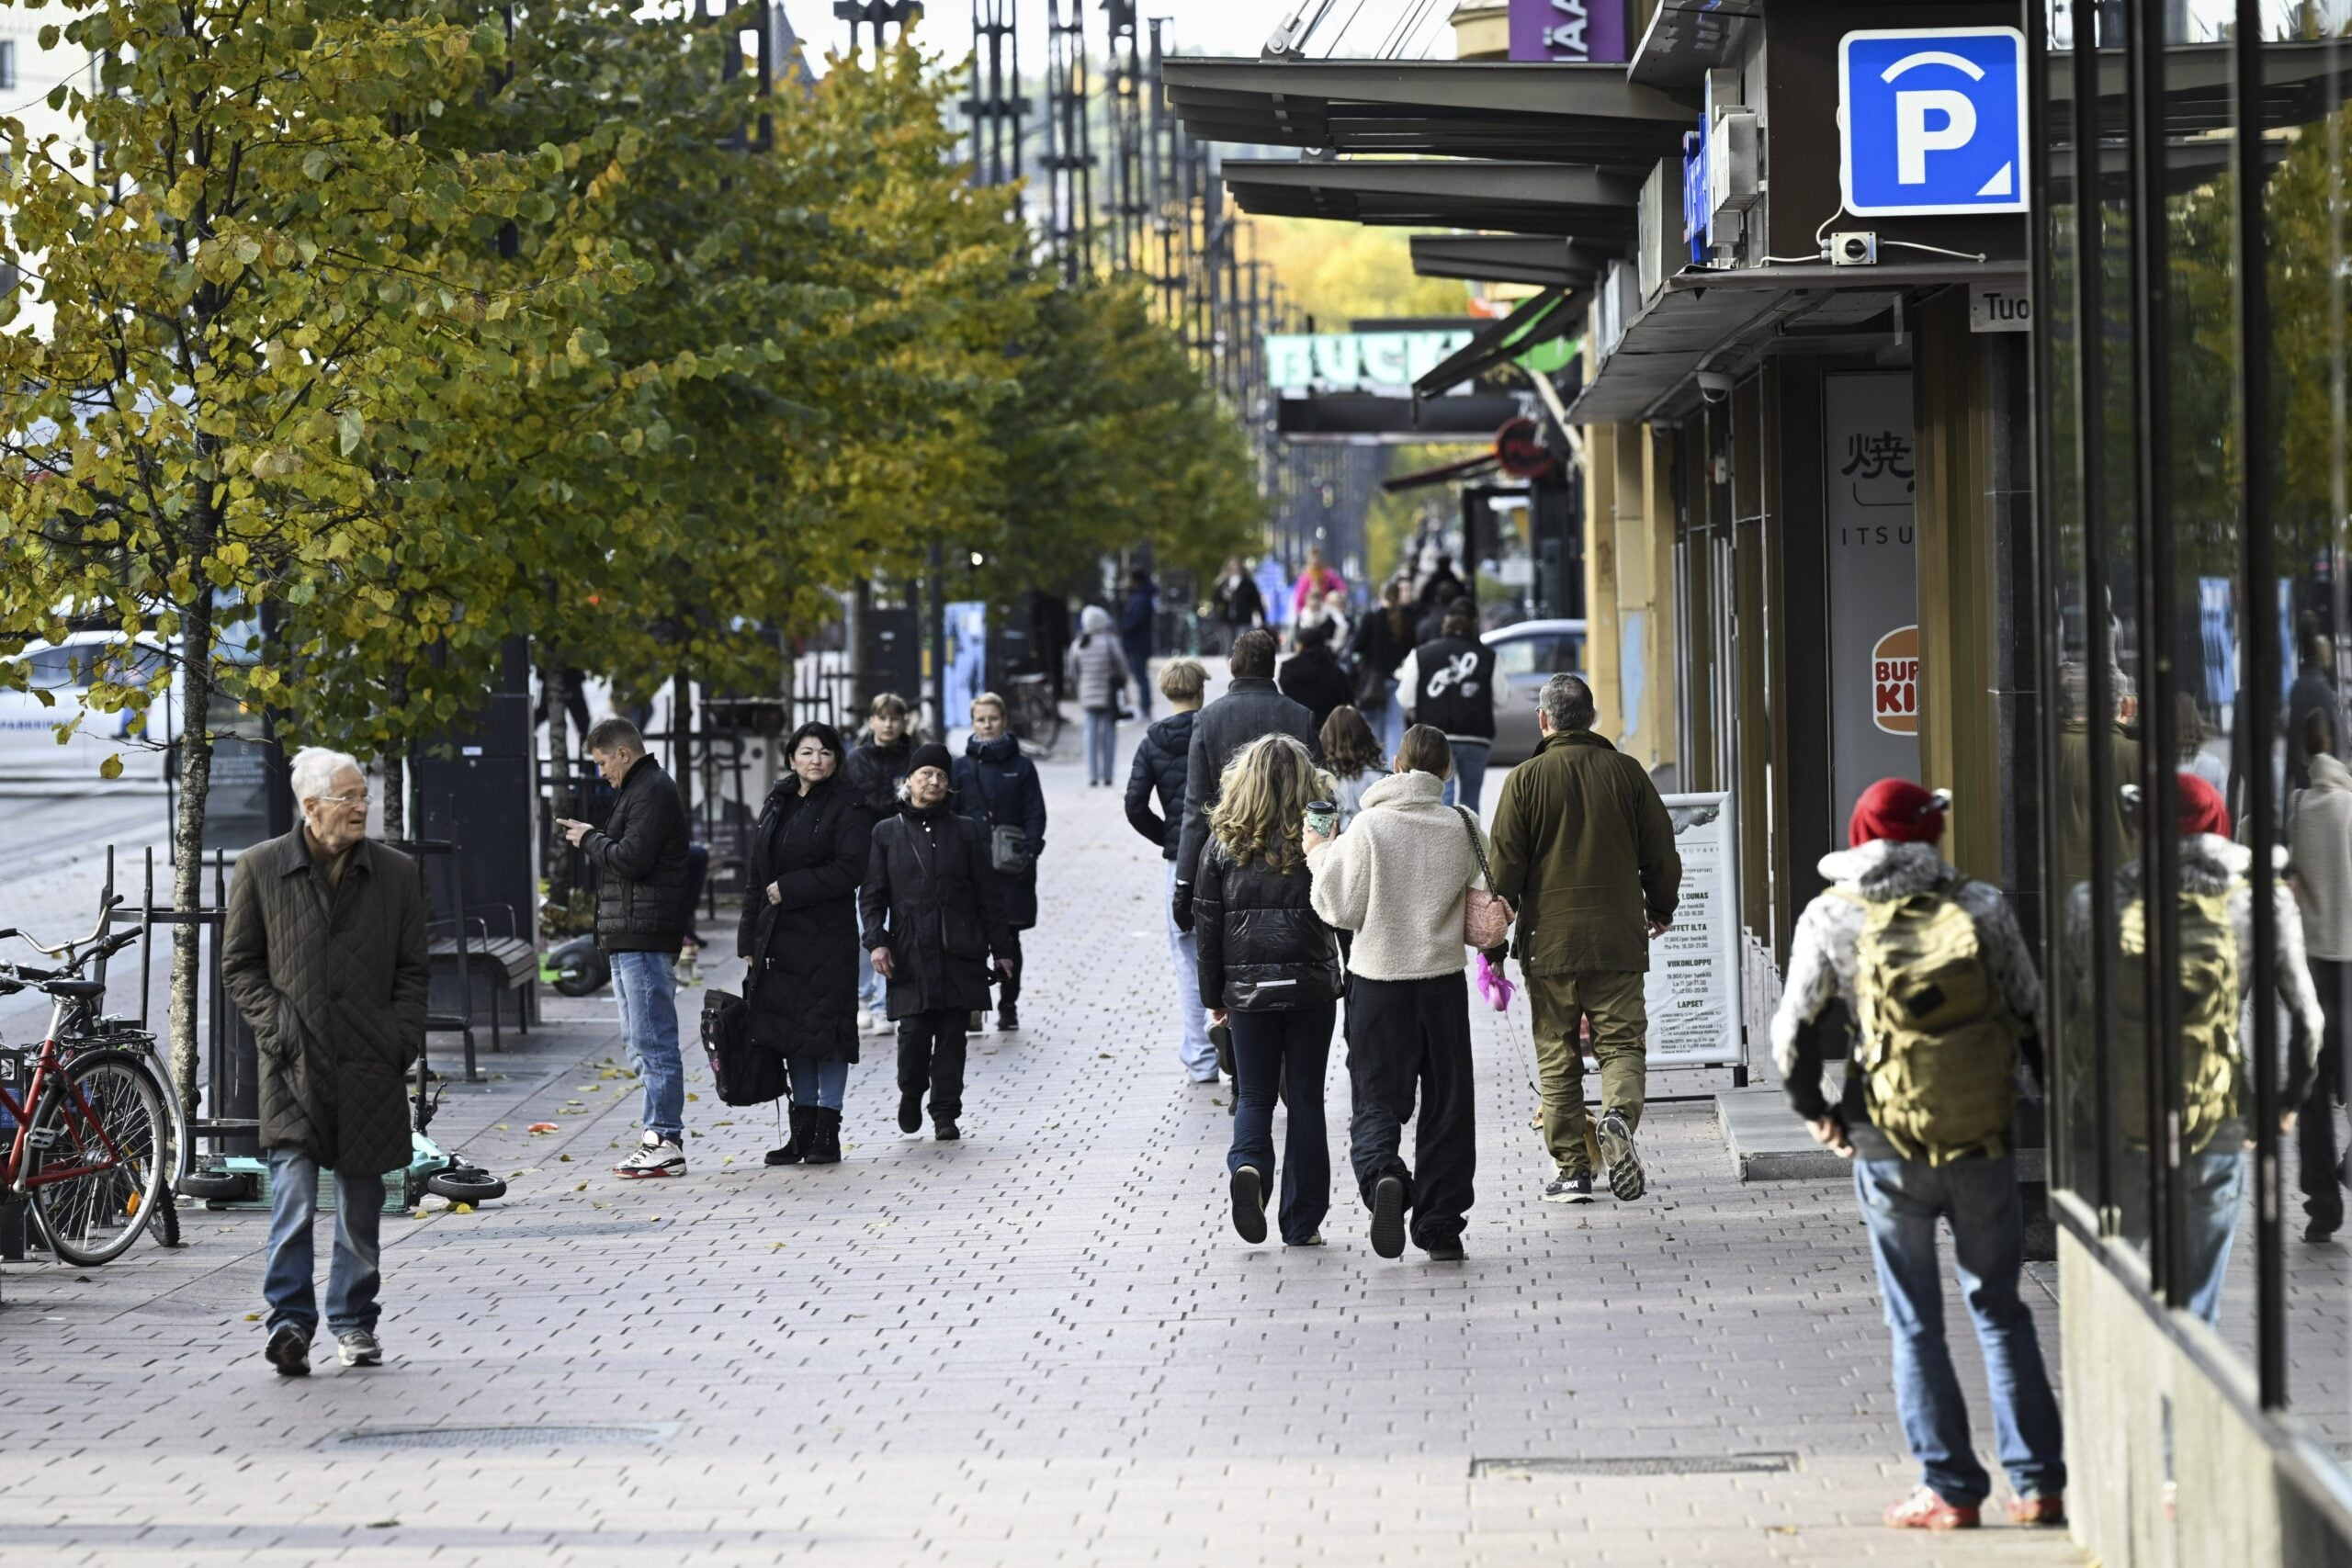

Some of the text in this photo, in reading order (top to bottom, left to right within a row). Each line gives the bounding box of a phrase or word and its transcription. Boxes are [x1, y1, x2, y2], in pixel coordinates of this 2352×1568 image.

[1896, 90, 1977, 185] P
[1842, 526, 1913, 546] ITSU
[1876, 683, 1915, 713] KI
[1682, 892, 1709, 900] LOUNAS
[1691, 923, 1707, 931] ILTA
[1668, 959, 1712, 967] VIIKONLOPPU
[1678, 999, 1703, 1008] LAPSET
